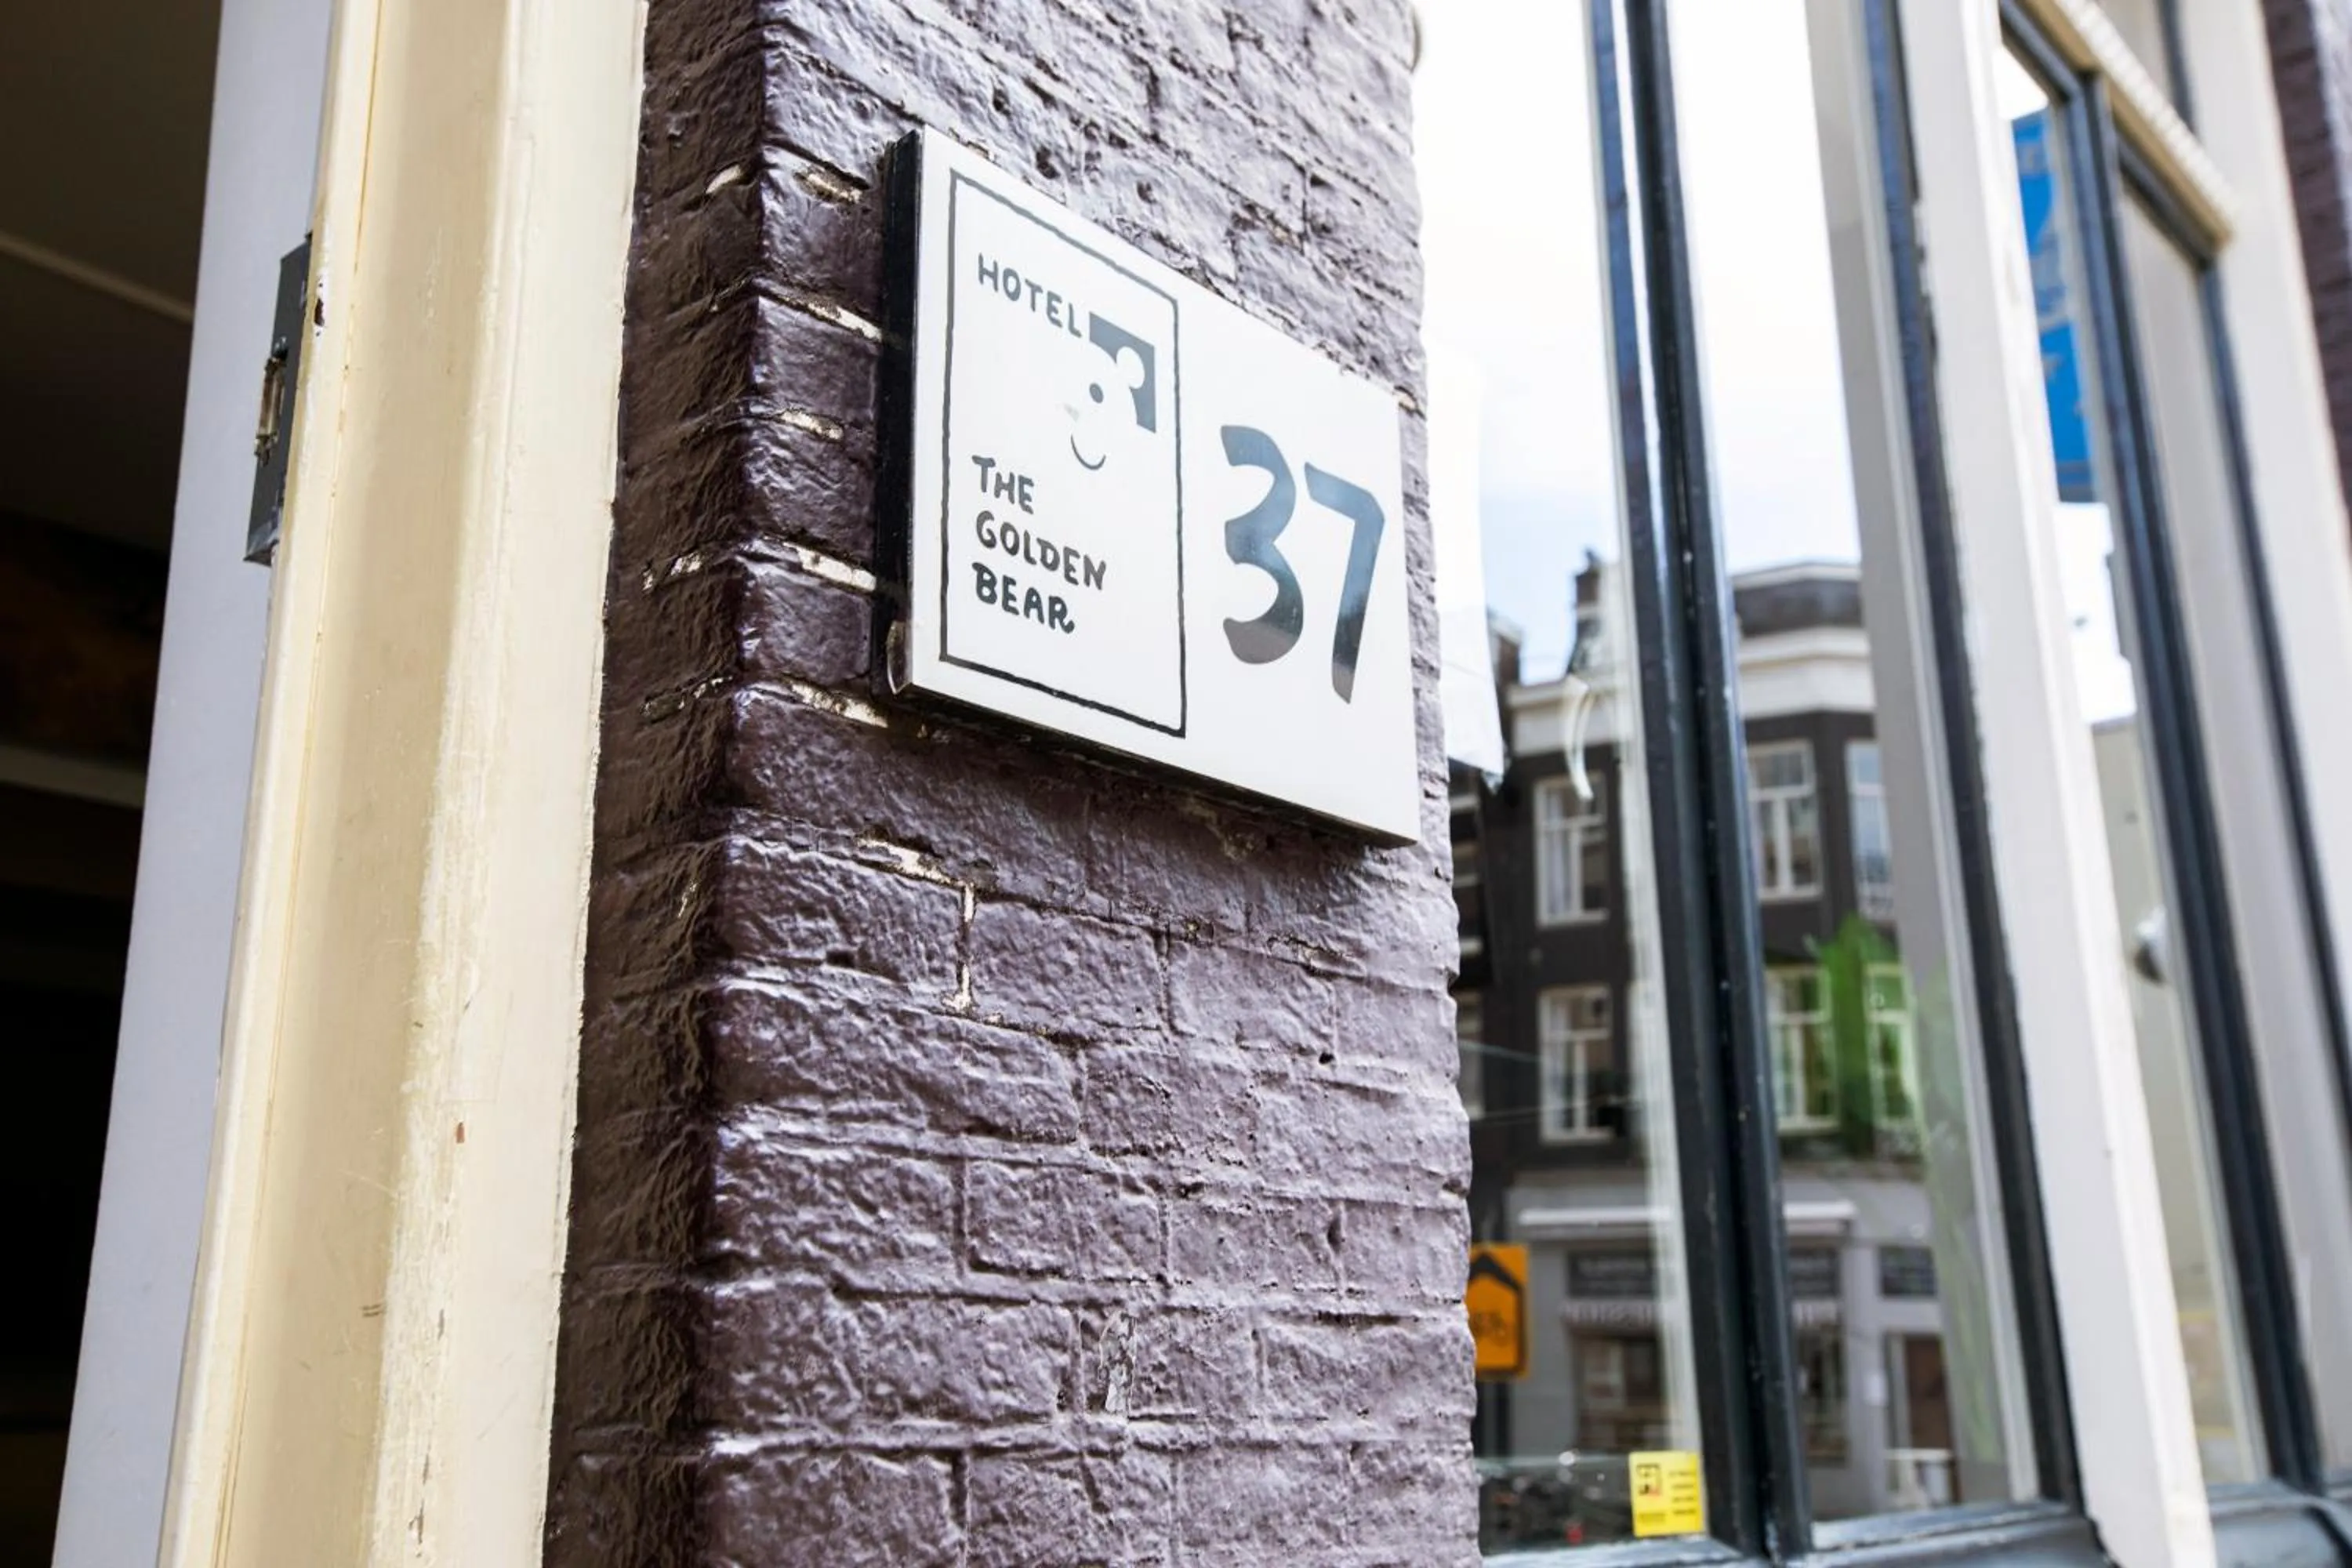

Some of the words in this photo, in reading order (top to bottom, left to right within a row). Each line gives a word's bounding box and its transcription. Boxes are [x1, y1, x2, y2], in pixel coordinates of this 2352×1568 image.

[977, 252, 1083, 339] HOTEL
[972, 455, 1036, 515] THE
[975, 510, 1107, 591] GOLDEN
[1220, 425, 1386, 704] 37
[971, 561, 1076, 634] BEAR
